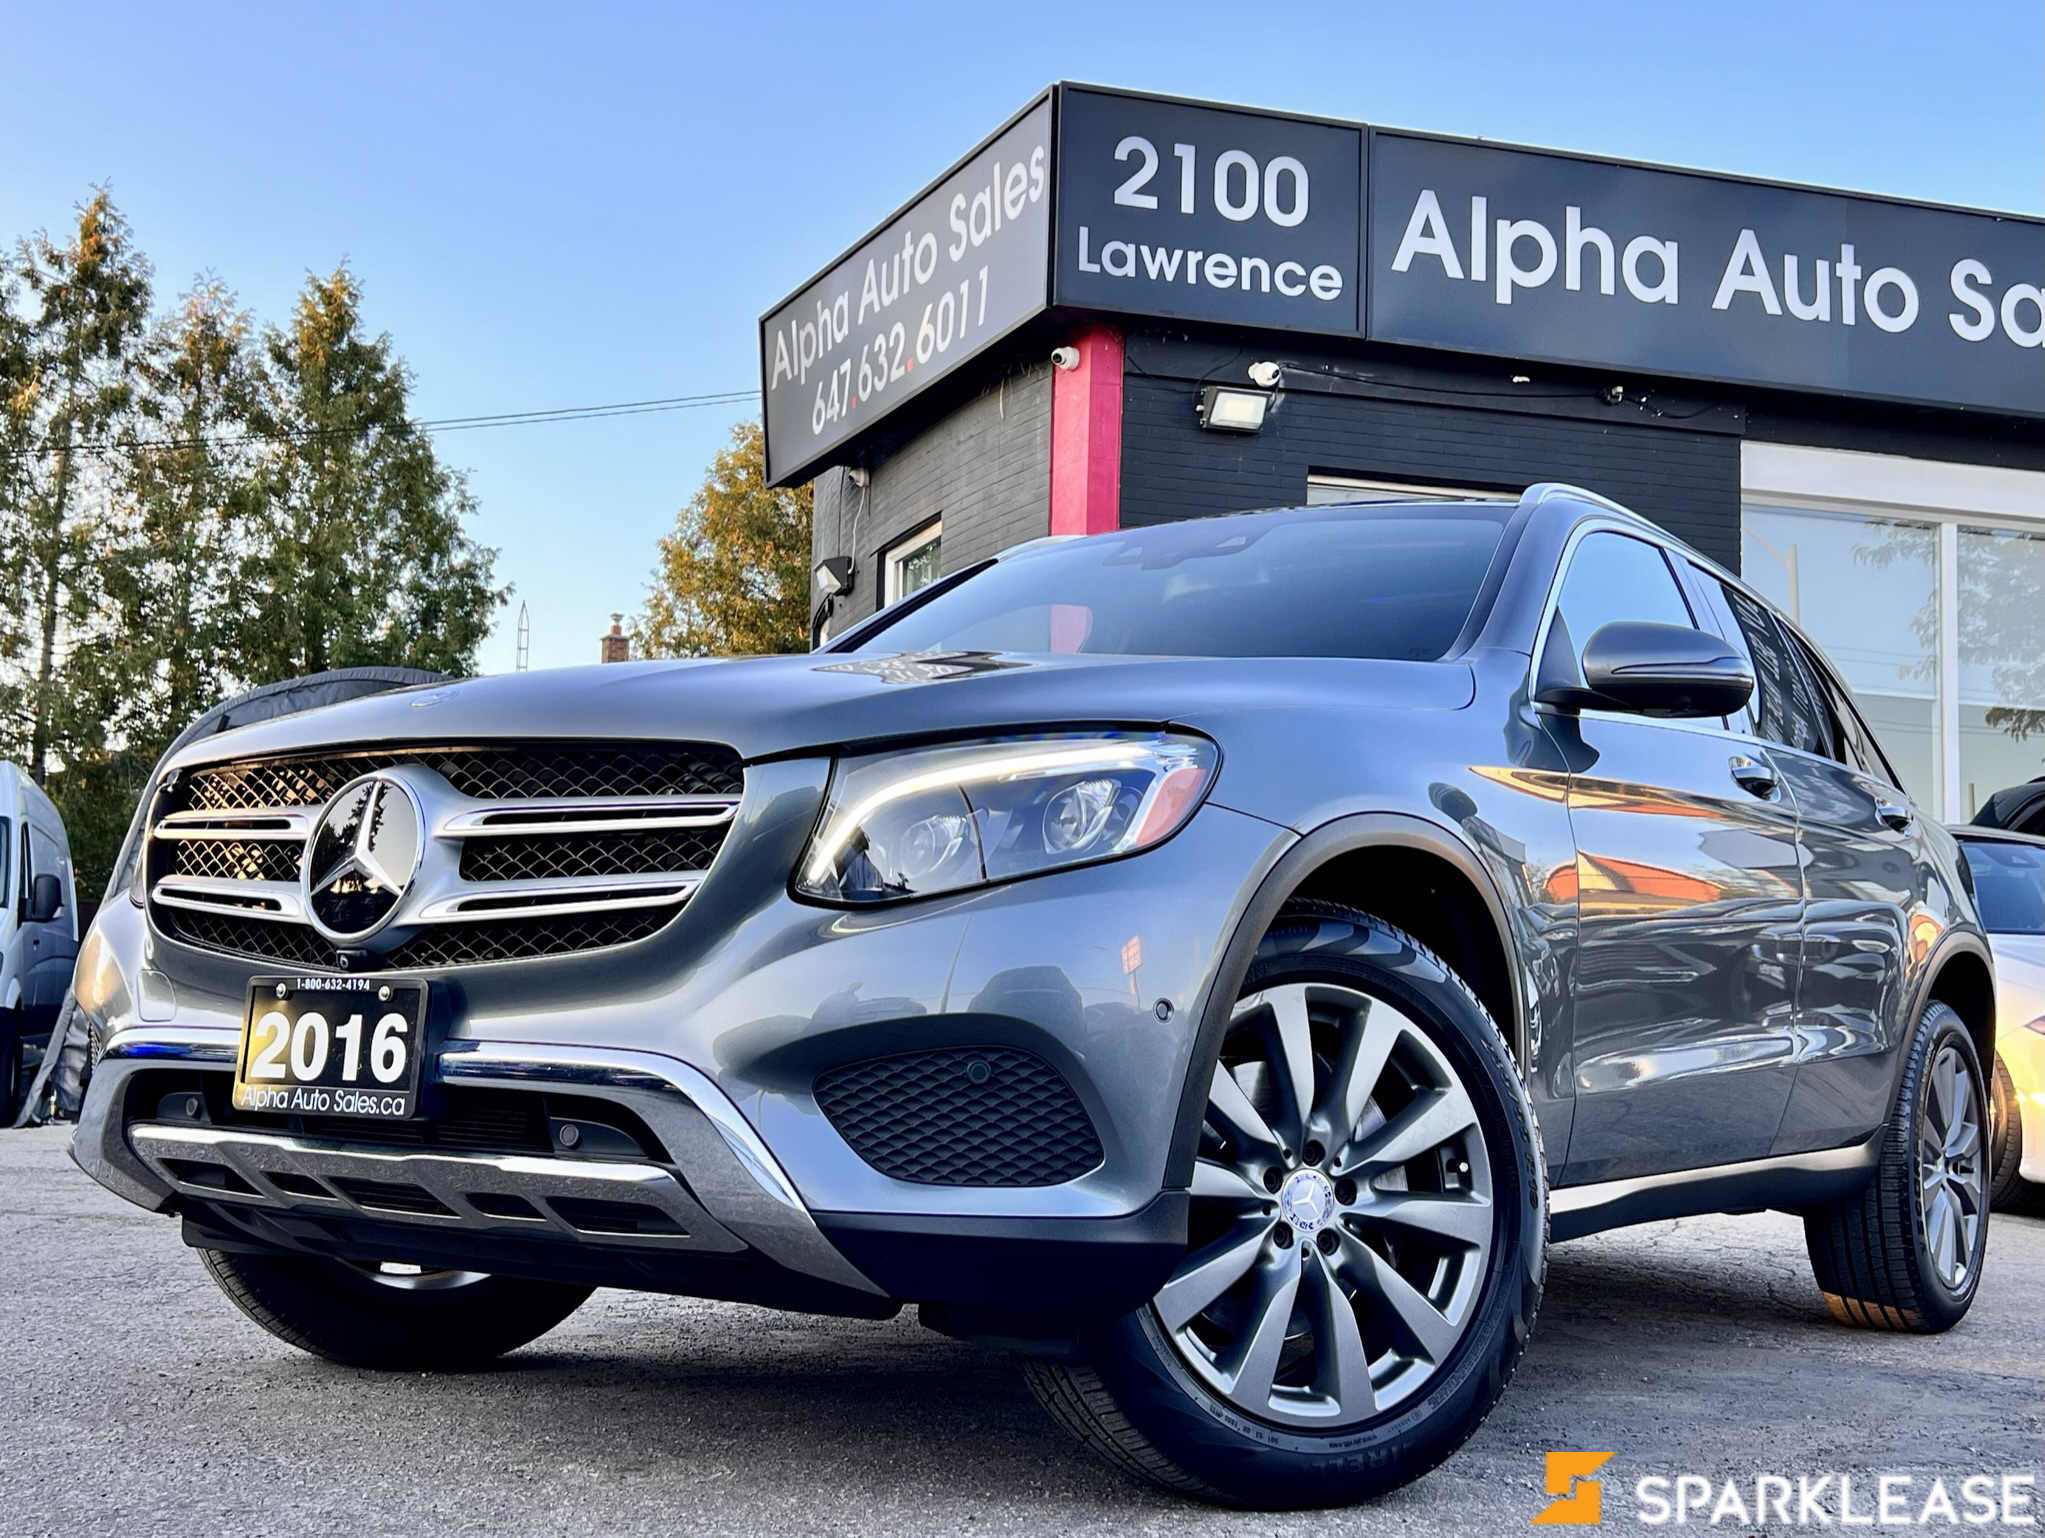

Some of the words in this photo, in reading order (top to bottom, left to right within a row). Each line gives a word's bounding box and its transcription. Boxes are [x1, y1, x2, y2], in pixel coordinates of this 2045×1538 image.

[1113, 136, 1310, 228] 2100
[771, 290, 849, 391] Alpha
[857, 231, 938, 325] Auto
[949, 145, 1045, 263] Sales
[1078, 226, 1344, 302] Lawrence
[1391, 189, 1679, 305] Alpha
[1711, 228, 1920, 334] Auto
[812, 265, 989, 436] 647.632.6011
[296, 978, 371, 991] 1-800-632-4194
[250, 1011, 408, 1084] 2016
[241, 1086, 289, 1111] Alpha
[291, 1088, 330, 1111] Auto
[333, 1090, 406, 1116] Sales.ca
